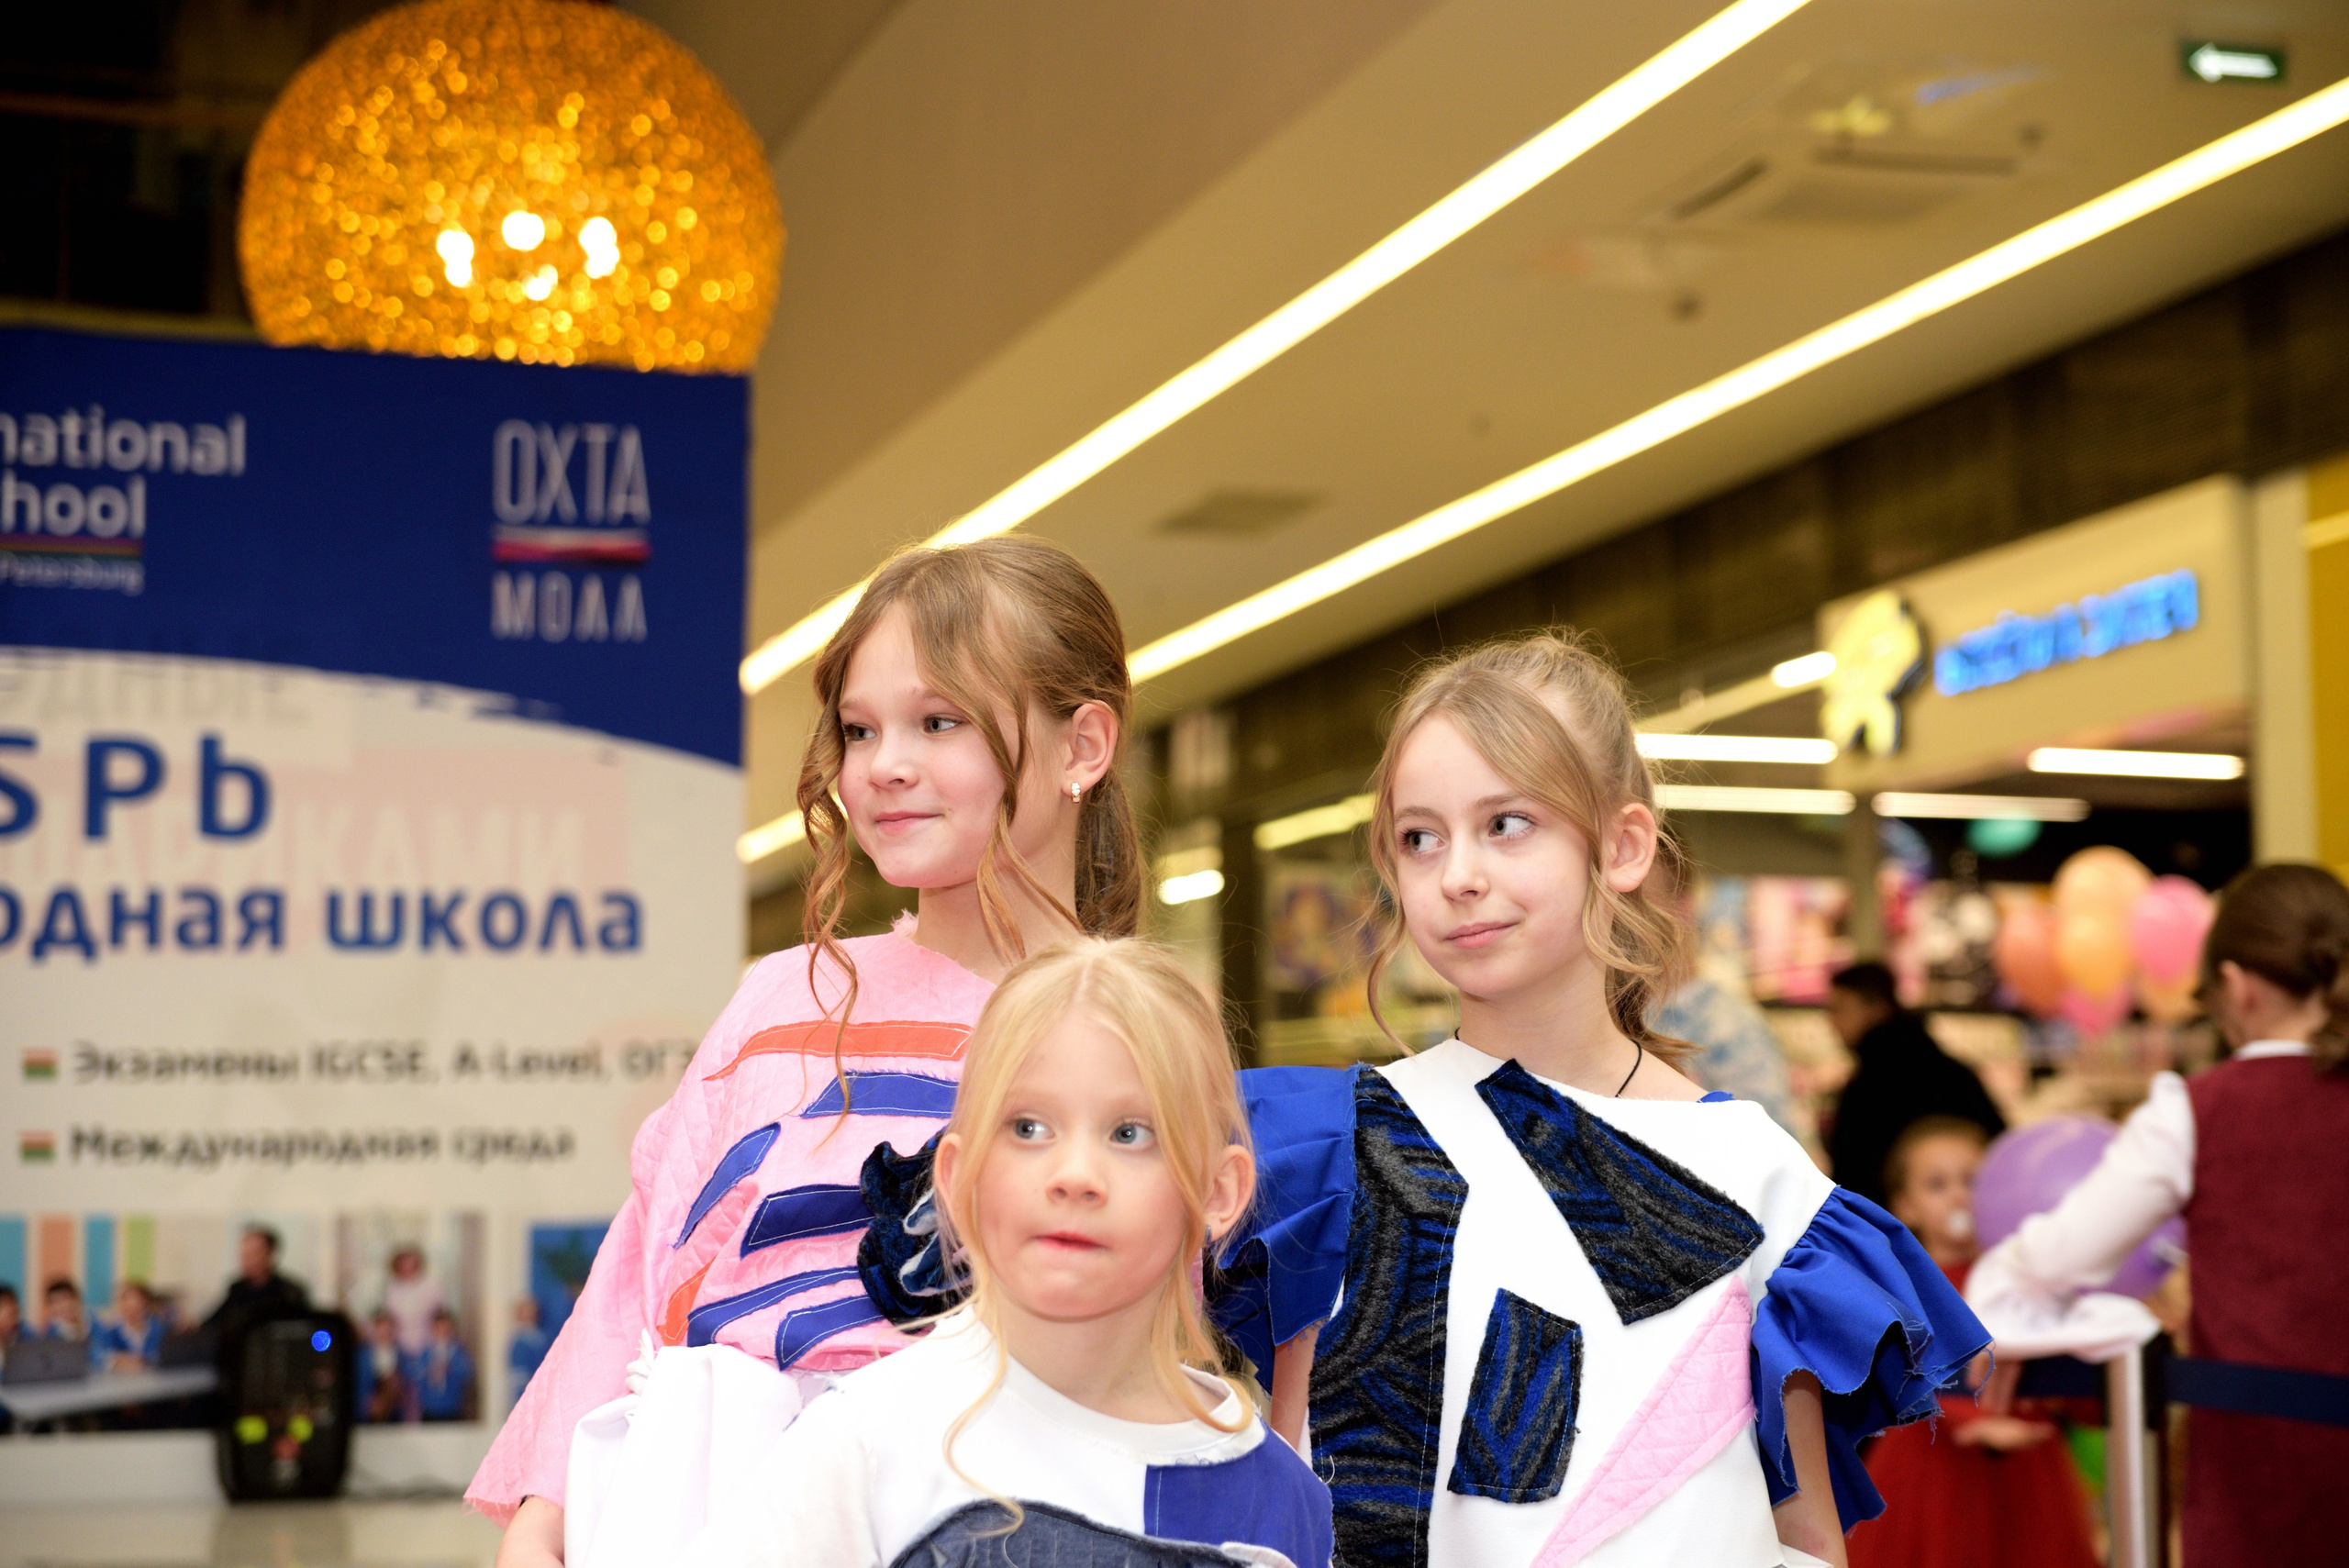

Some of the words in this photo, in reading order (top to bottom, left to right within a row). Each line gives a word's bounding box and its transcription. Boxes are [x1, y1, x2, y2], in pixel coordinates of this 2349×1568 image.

[493, 419, 651, 525] ОХТА
[324, 886, 648, 955] школа
[72, 1040, 300, 1084] Экзамены
[70, 1124, 441, 1175] Международная
[451, 1128, 577, 1168] среда
